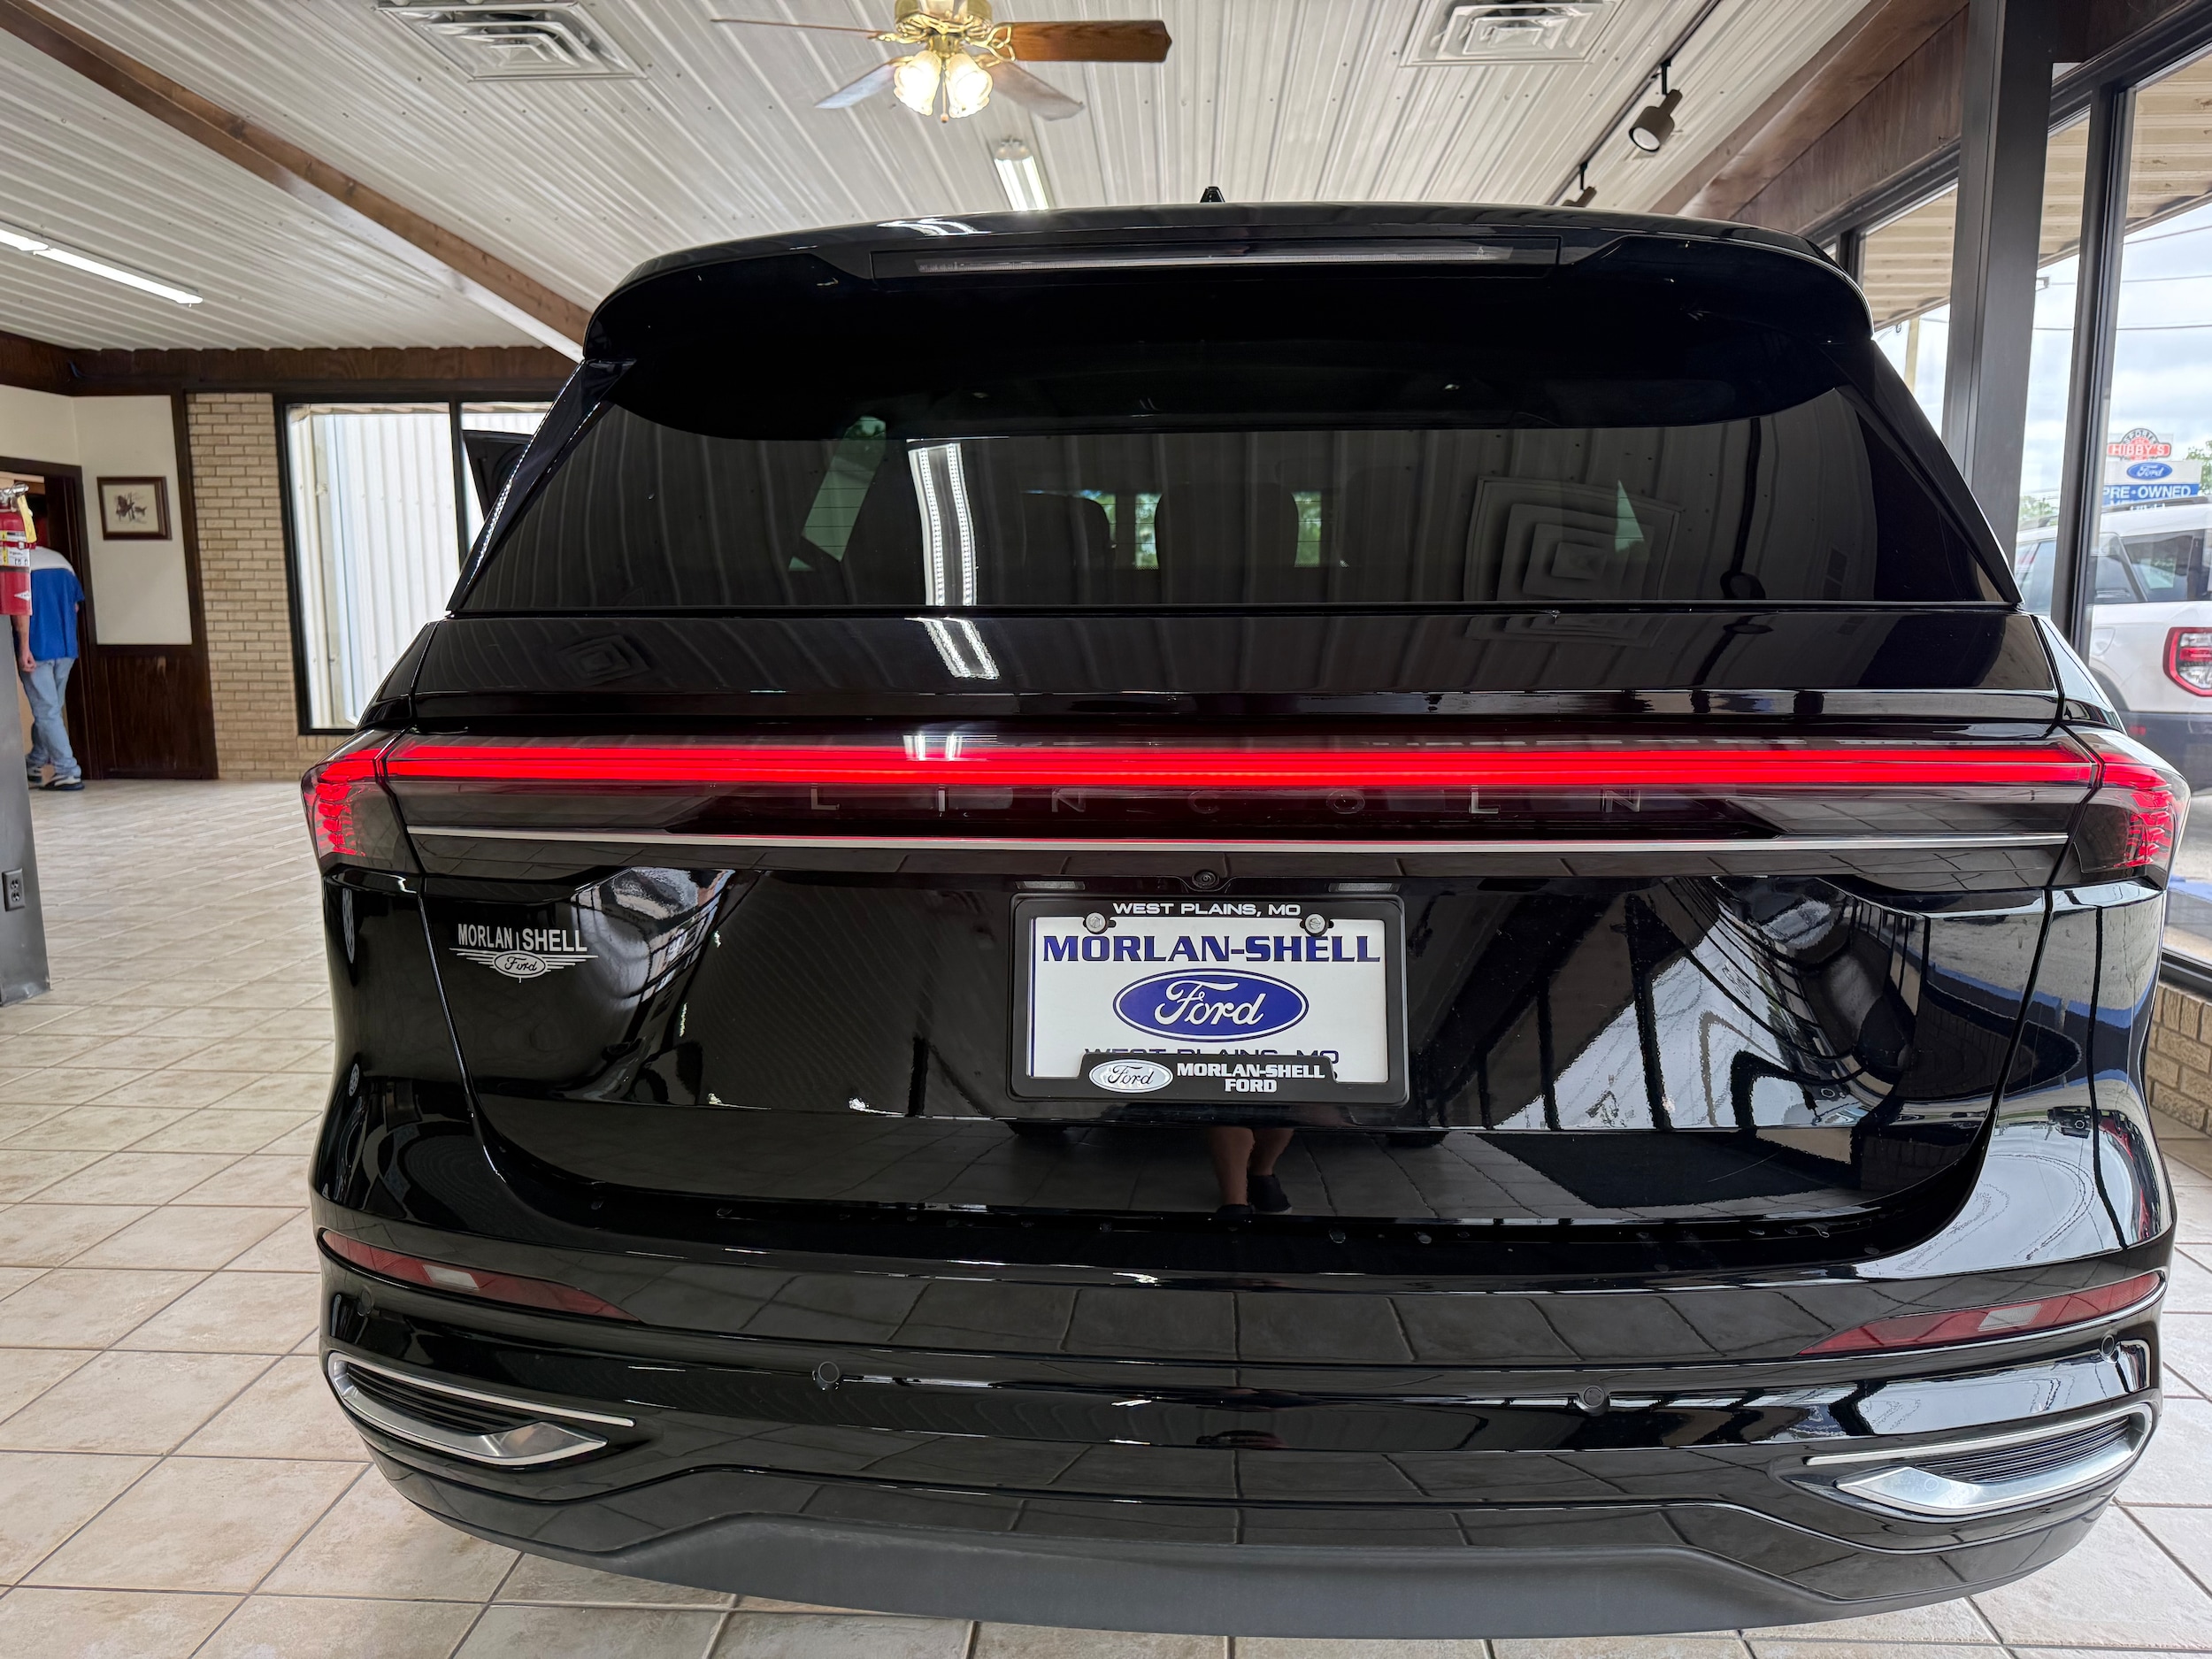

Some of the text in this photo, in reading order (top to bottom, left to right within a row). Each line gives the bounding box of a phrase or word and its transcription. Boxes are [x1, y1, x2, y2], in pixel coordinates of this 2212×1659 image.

[2137, 465, 2164, 477] Ford
[810, 784, 1641, 814] LINCOLN
[1113, 902, 1302, 918] WEST PLAINS, MO
[457, 923, 588, 952] MORLAN SHELL
[1043, 935, 1381, 963] MORLAN-SHELL
[503, 956, 538, 972] Ford
[1154, 979, 1267, 1025] Ford
[1107, 1064, 1154, 1086] Ford
[1177, 1063, 1325, 1079] MORLAN-SHELL
[1225, 1079, 1278, 1093] FORD
